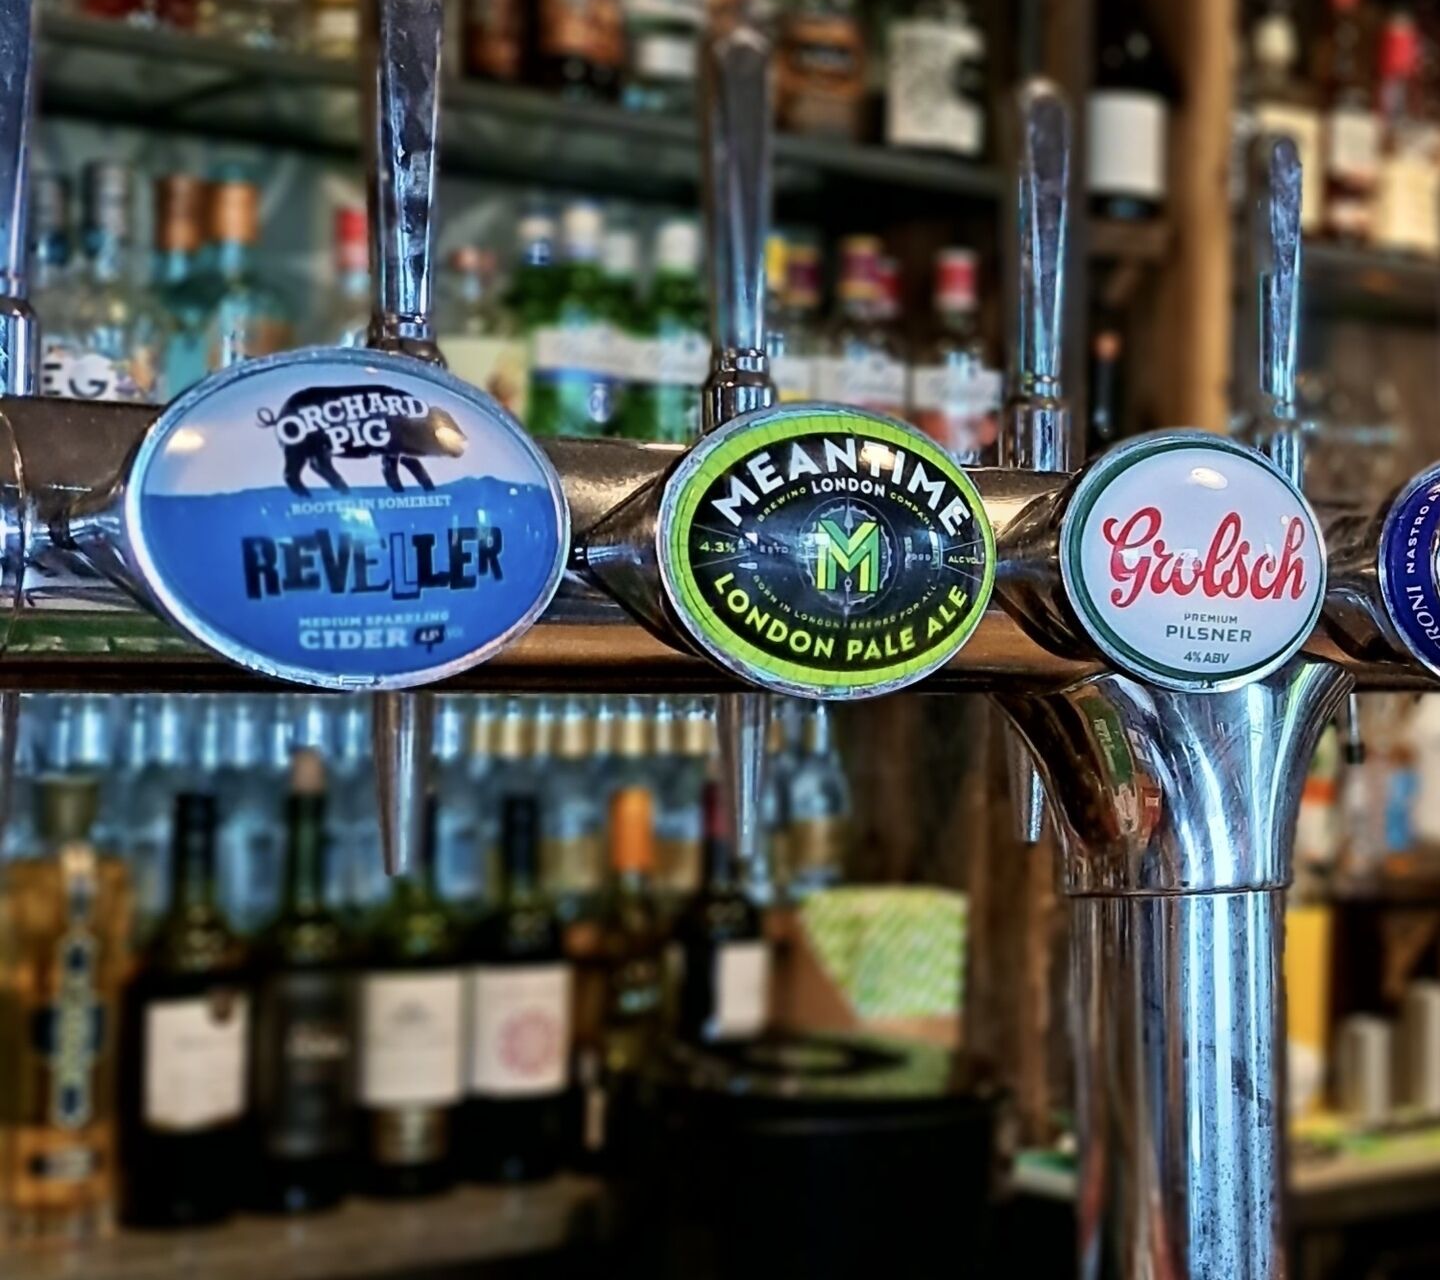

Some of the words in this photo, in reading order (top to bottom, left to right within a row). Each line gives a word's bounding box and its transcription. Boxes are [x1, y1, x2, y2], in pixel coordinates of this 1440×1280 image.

[276, 392, 430, 445] ORCHARD
[325, 419, 391, 455] PIG
[711, 437, 973, 538] MEANTIME
[811, 477, 886, 499] LONDON
[378, 494, 452, 510] SOMERSET
[699, 541, 737, 554] 4.3%
[1406, 505, 1430, 574] NASTRO
[241, 525, 503, 601] REVELLER
[1102, 506, 1308, 609] Grolsch
[299, 616, 362, 627] MEDIUM
[714, 571, 834, 660] LONDON
[846, 626, 917, 662] PALE
[926, 584, 969, 640] ALE
[1183, 612, 1239, 625] PREMIUM
[299, 627, 409, 650] CIDER
[1165, 624, 1252, 643] PILSNER
[1202, 651, 1230, 665] ABV
